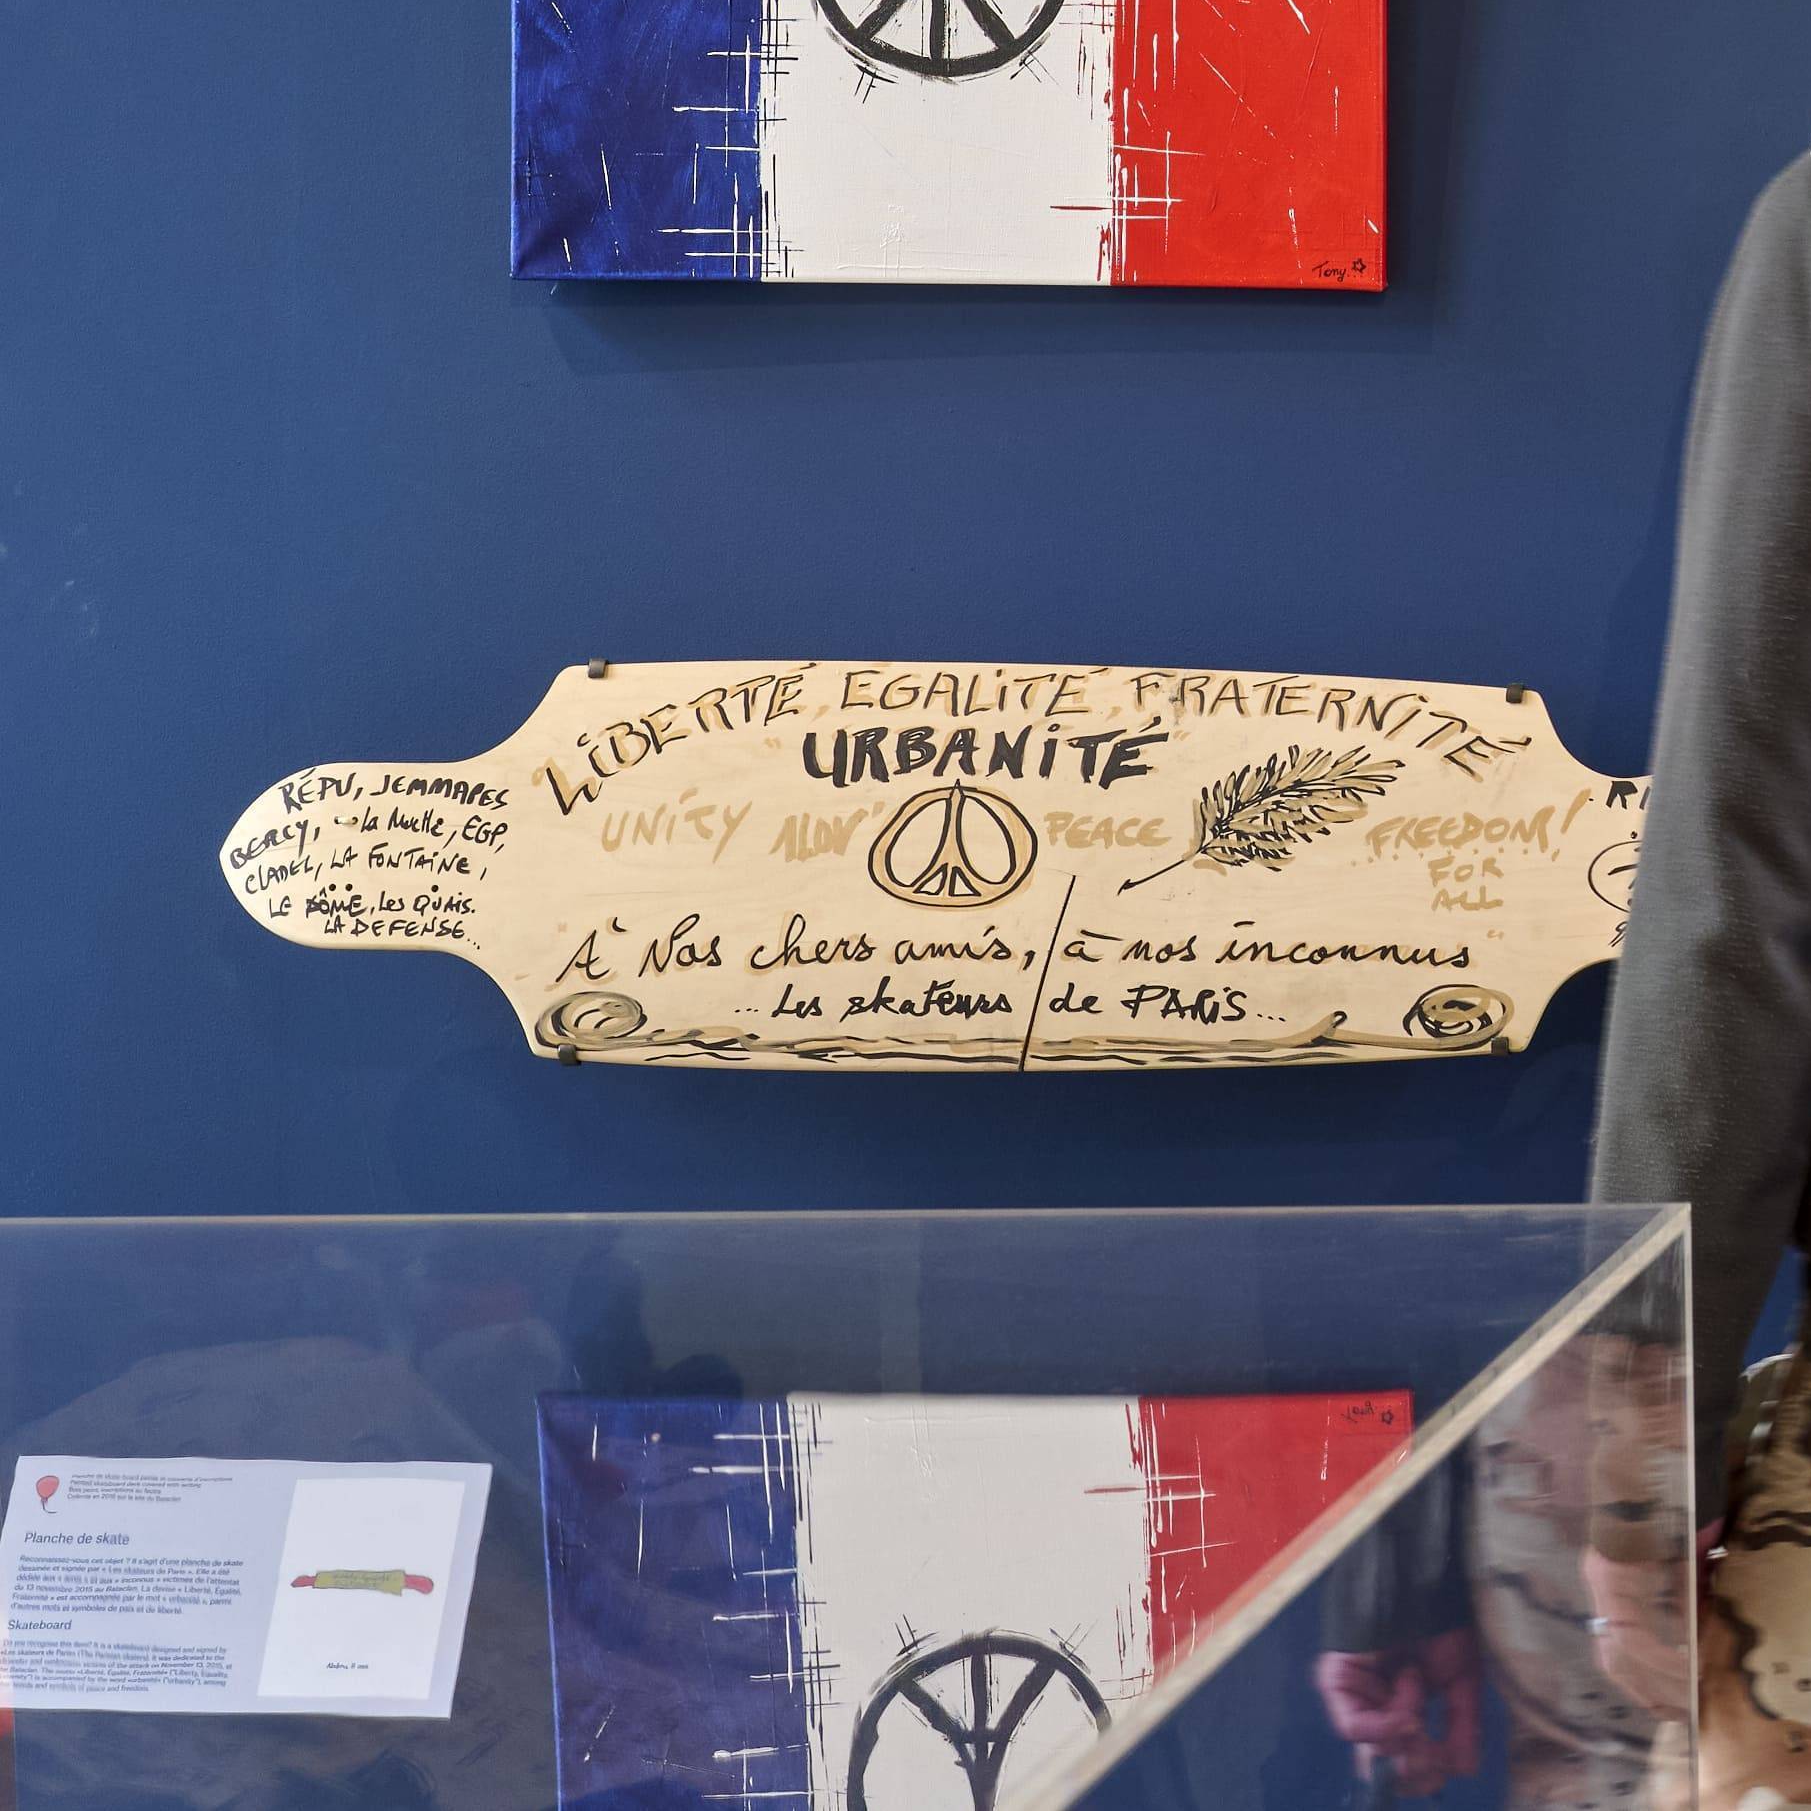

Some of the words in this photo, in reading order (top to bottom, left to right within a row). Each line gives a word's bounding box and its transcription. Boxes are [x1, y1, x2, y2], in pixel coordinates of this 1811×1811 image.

[369, 774, 509, 810] JEMMAPES
[1045, 810, 1172, 852] PEACE
[331, 847, 358, 869] LA
[1427, 856, 1503, 887] FOR
[268, 895, 292, 918] LE
[324, 916, 346, 935] LA
[750, 913, 877, 971] chers
[1122, 935, 1197, 964] nos
[1215, 921, 1470, 967] inconnus
[840, 976, 1012, 1023] skateurs
[1049, 983, 1102, 1016] de
[24, 1532, 73, 1544] Planche
[77, 1533, 93, 1544] de
[96, 1533, 130, 1546] skate
[7, 1619, 72, 1630] Skateboard
